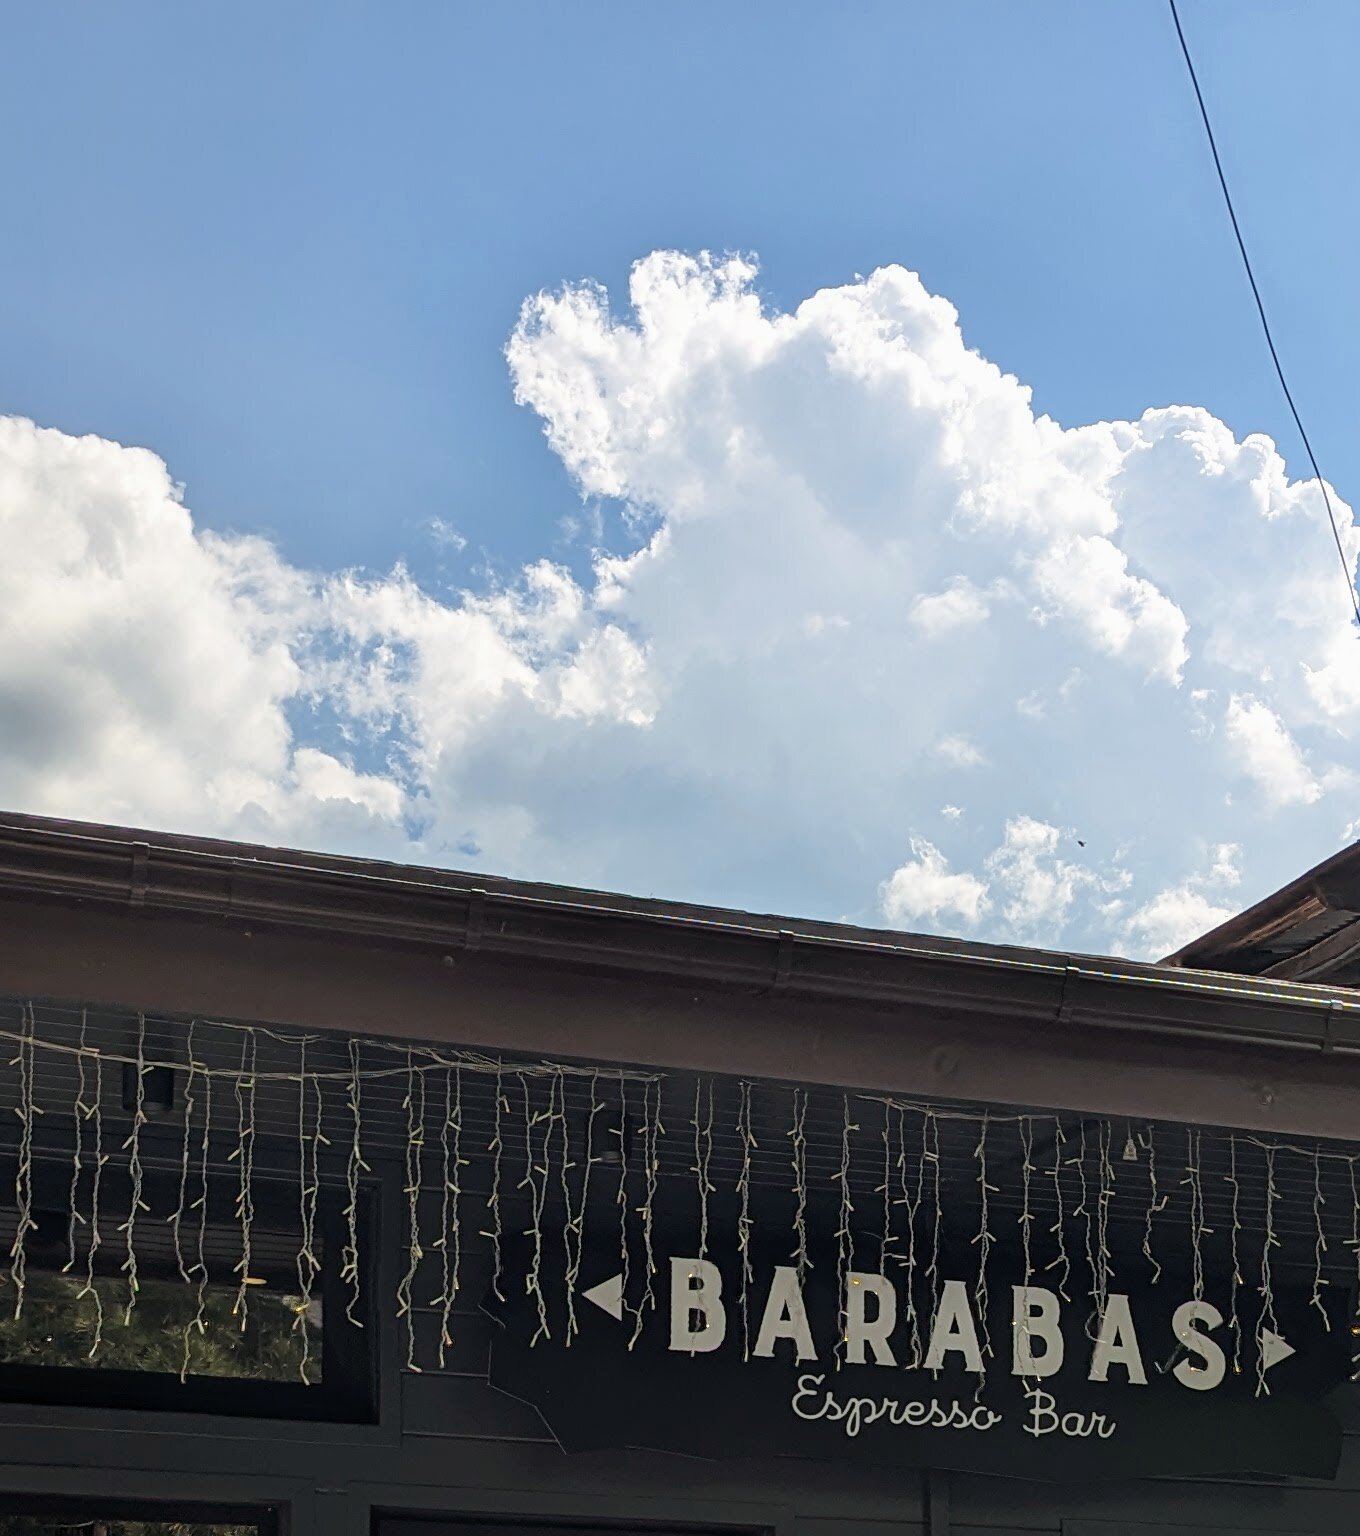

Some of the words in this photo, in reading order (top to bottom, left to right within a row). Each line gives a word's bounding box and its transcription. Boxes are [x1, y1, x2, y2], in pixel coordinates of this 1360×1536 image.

[668, 1255, 1227, 1391] BARABAS
[792, 1374, 1001, 1435] Espresso
[1023, 1389, 1117, 1439] Bar
